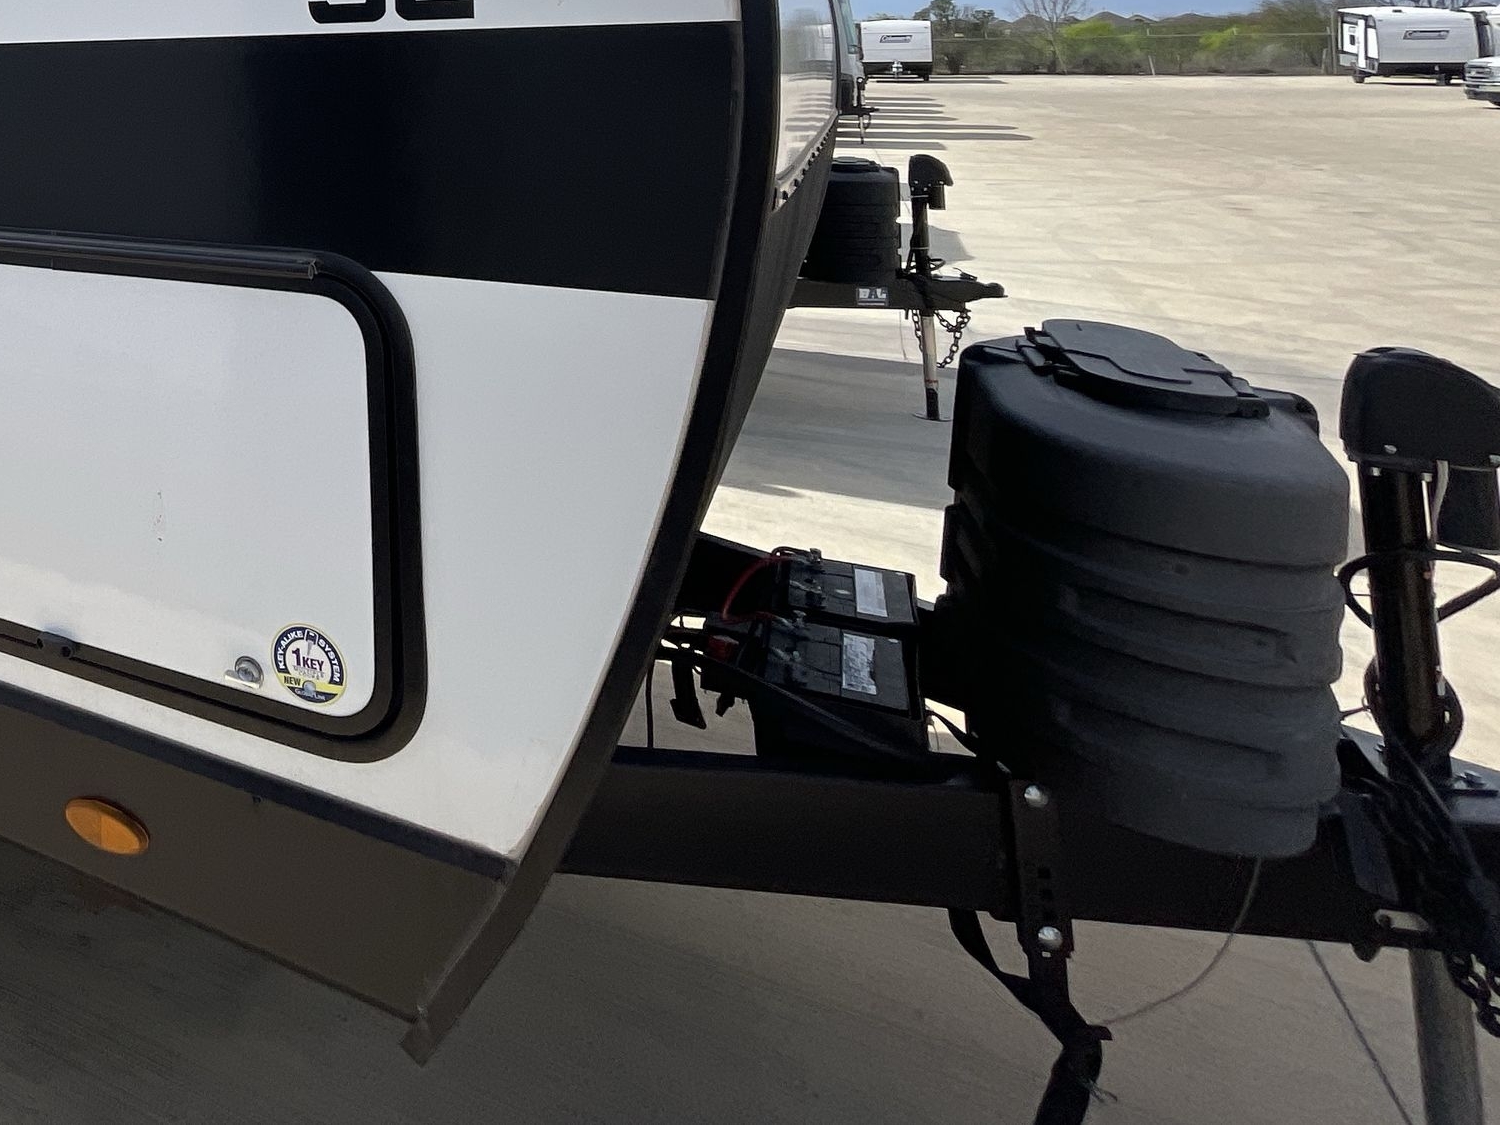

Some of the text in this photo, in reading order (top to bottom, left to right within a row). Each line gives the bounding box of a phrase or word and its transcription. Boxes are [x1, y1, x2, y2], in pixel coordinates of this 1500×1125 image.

[276, 630, 341, 683] KEY-ALIKE SYSTEM
[283, 675, 302, 687] NEW
